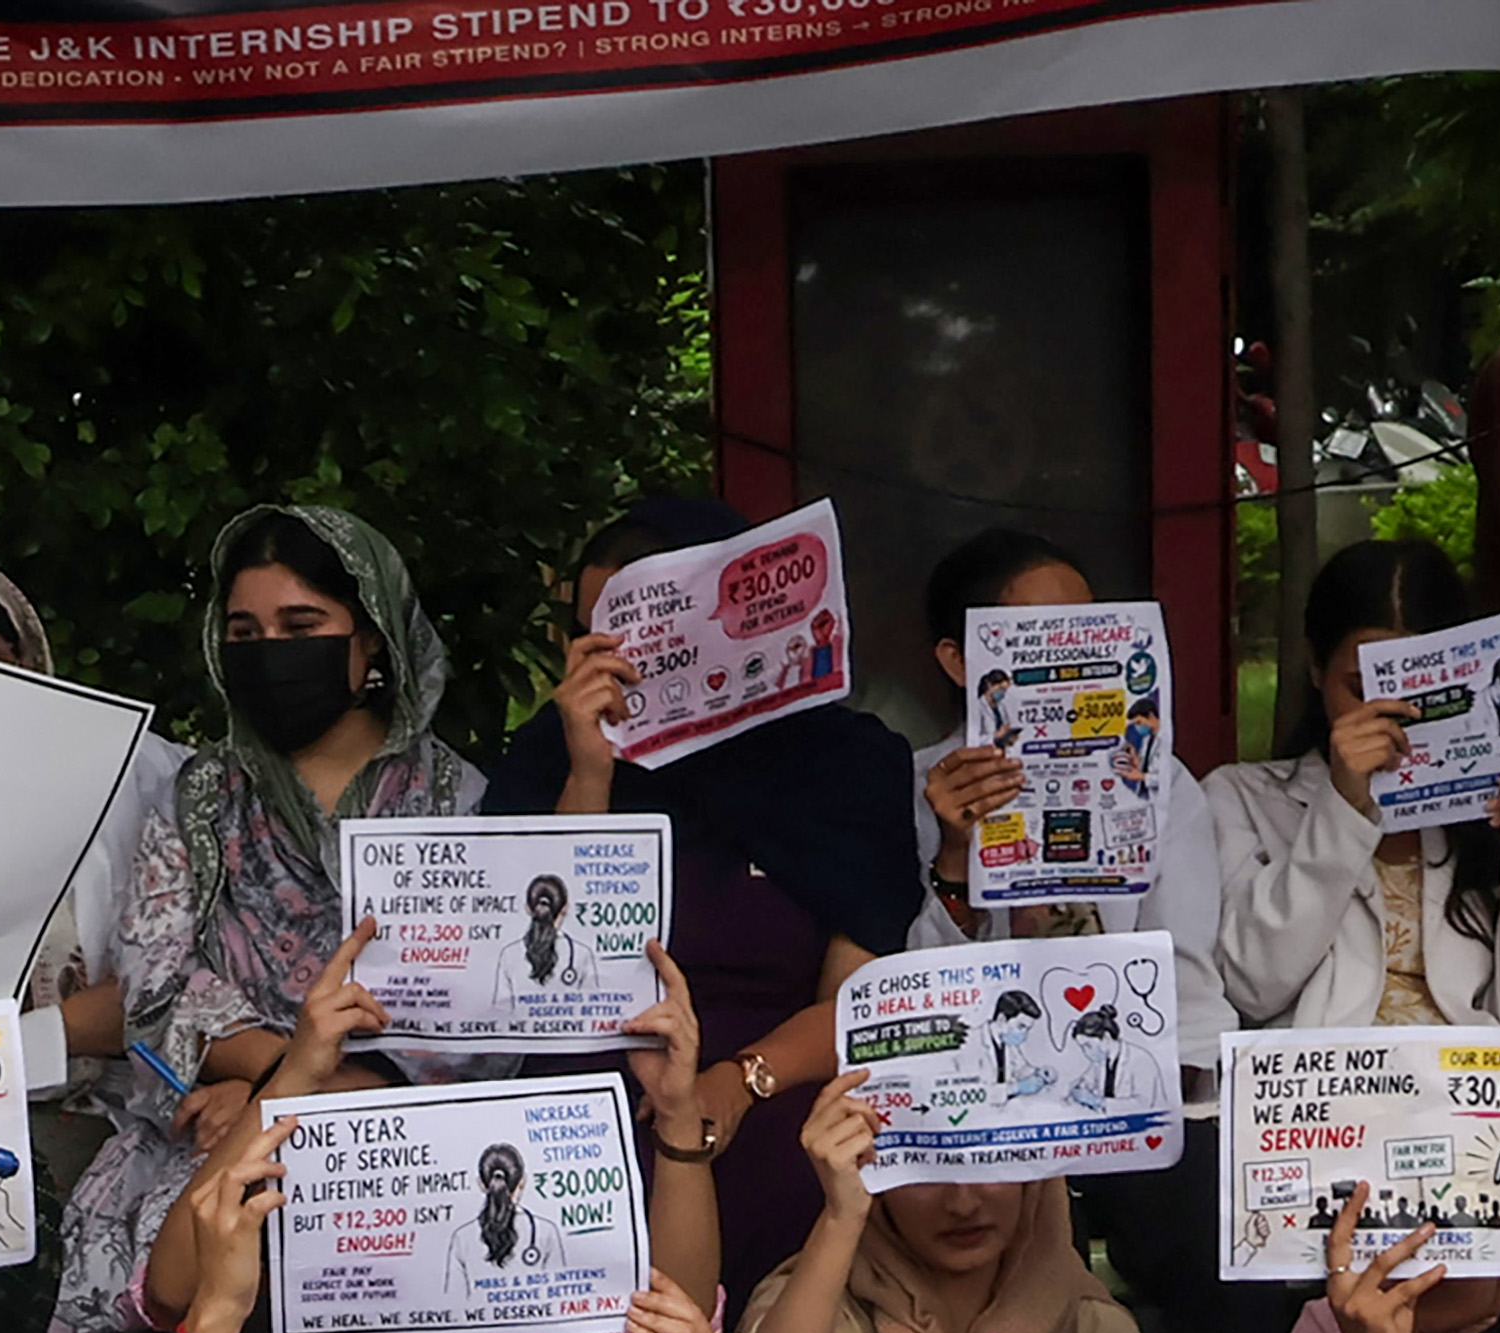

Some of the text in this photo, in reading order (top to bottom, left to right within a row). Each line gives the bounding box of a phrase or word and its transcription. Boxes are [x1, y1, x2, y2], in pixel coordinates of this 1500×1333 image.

[1, 68, 164, 88] DEDICATION
[192, 66, 253, 87] WHY
[265, 61, 320, 80] NOT
[331, 57, 349, 75] A
[360, 48, 424, 74] FAIR
[433, 40, 568, 68] STIPEND?
[595, 30, 710, 55] STRONG
[720, 21, 842, 44] INTERNS
[880, 0, 993, 29] STRONG
[30, 36, 117, 63] J&K
[134, 13, 413, 60] INTERNSHIP
[432, 3, 631, 40] STIPEND
[664, 0, 711, 22] TO
[729, 556, 816, 603] ₹30,000
[1048, 626, 1132, 648] HEALTHCARE
[575, 902, 656, 927] ₹30,000
[850, 971, 932, 1002] WE CHOSE
[525, 1104, 591, 1124] INCREASE
[290, 1117, 407, 1150] ONE YEAR
[528, 1123, 610, 1145] INTERNSHIP
[1259, 1124, 1366, 1152] SERVING!
[326, 1146, 438, 1173] OF SERVICE.
[561, 1205, 614, 1227] NOW!
